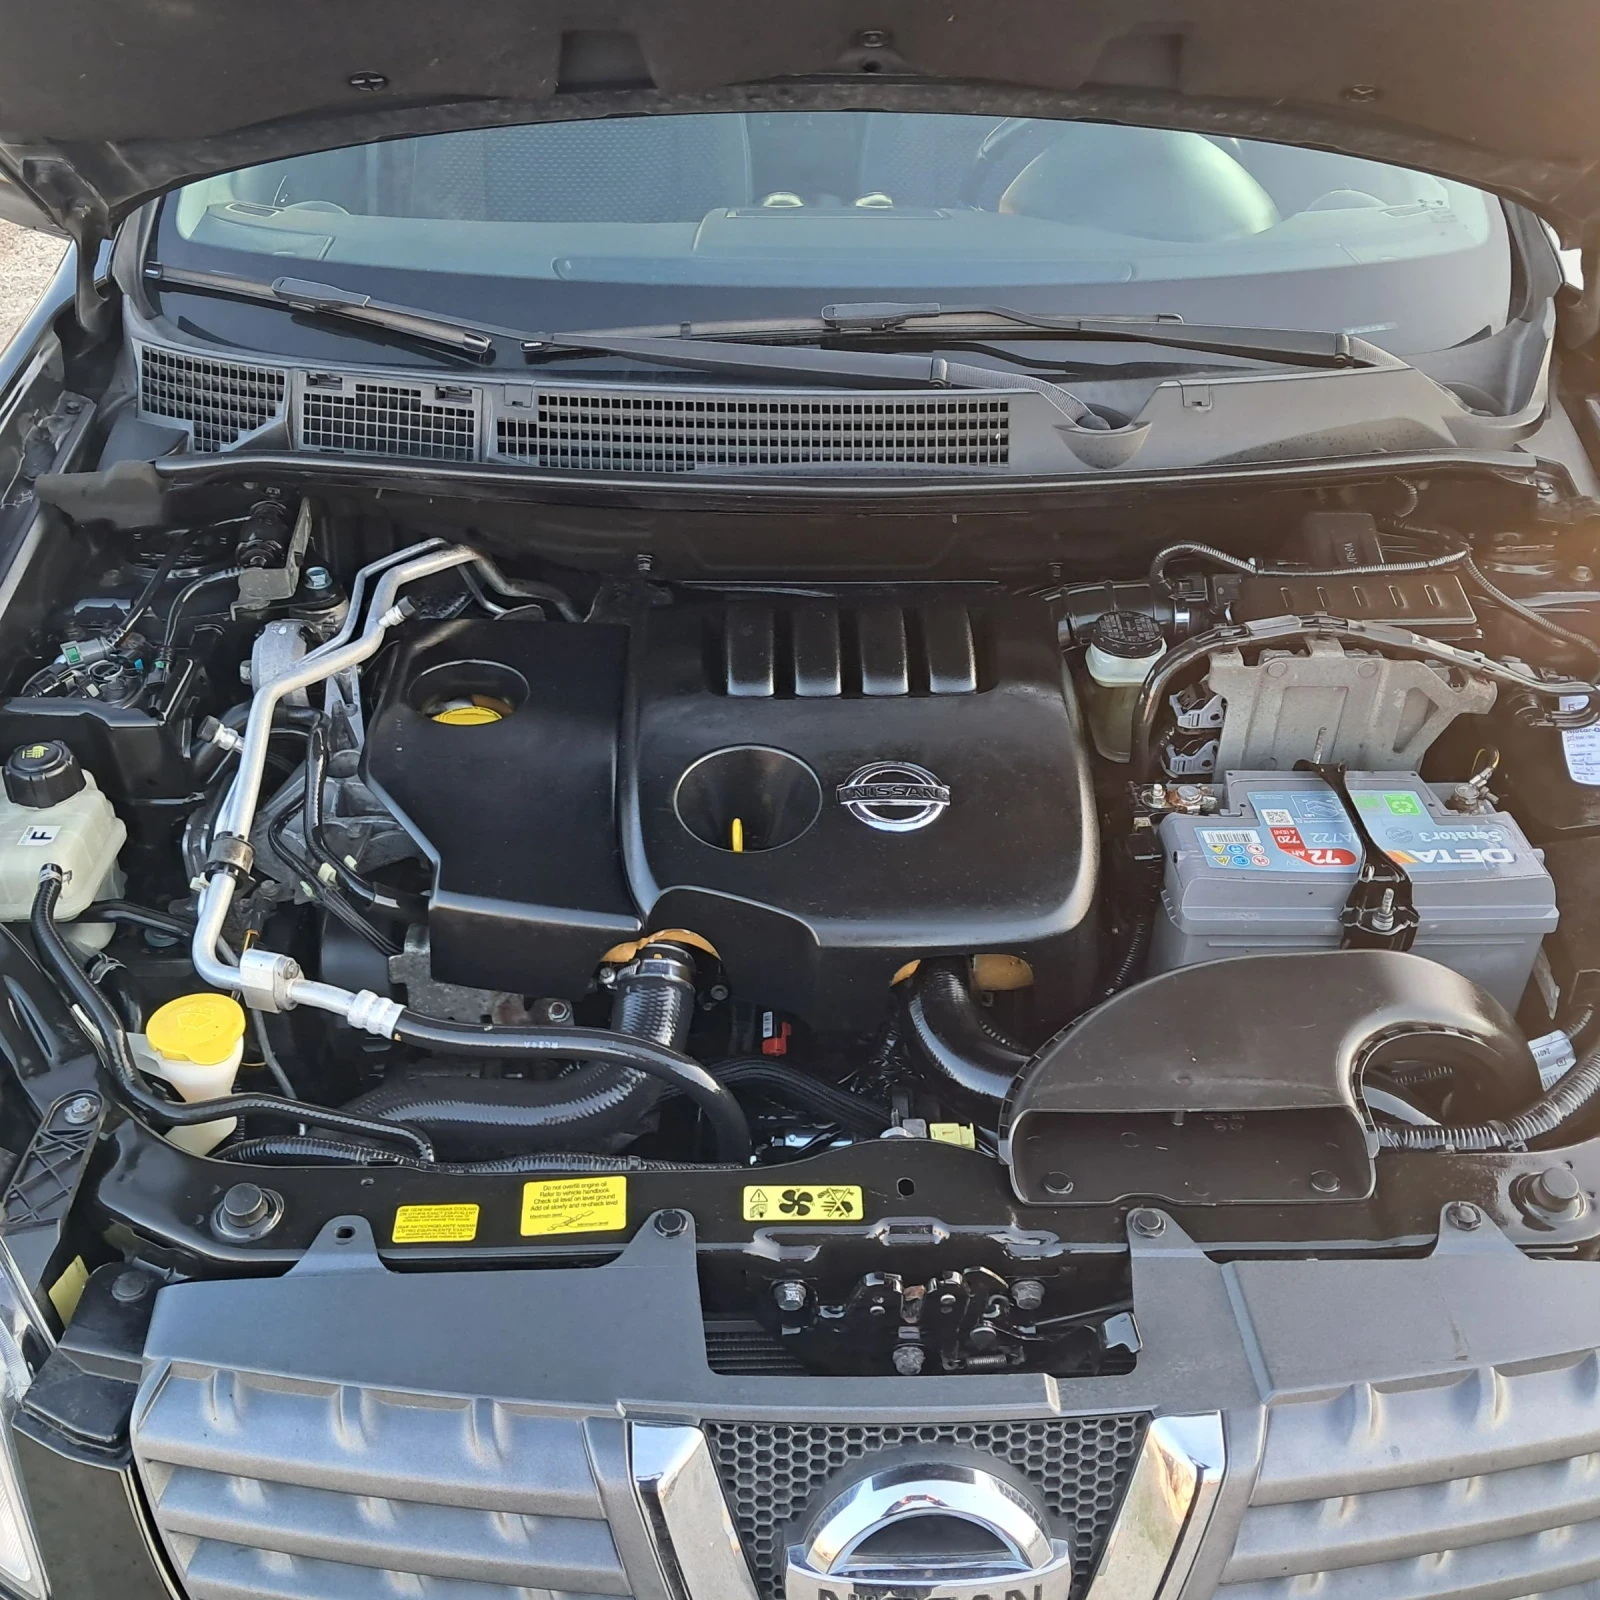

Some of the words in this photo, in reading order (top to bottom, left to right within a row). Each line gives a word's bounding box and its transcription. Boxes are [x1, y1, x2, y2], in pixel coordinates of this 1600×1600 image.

[852, 785, 938, 799] NISSAN
[30, 831, 52, 840] F
[1277, 835, 1301, 844] 720
[1419, 829, 1503, 842] Senator3
[1291, 849, 1306, 857] Ah
[1308, 849, 1342, 864] 72
[1415, 848, 1516, 863] DETA
[596, 1193, 615, 1201] ground
